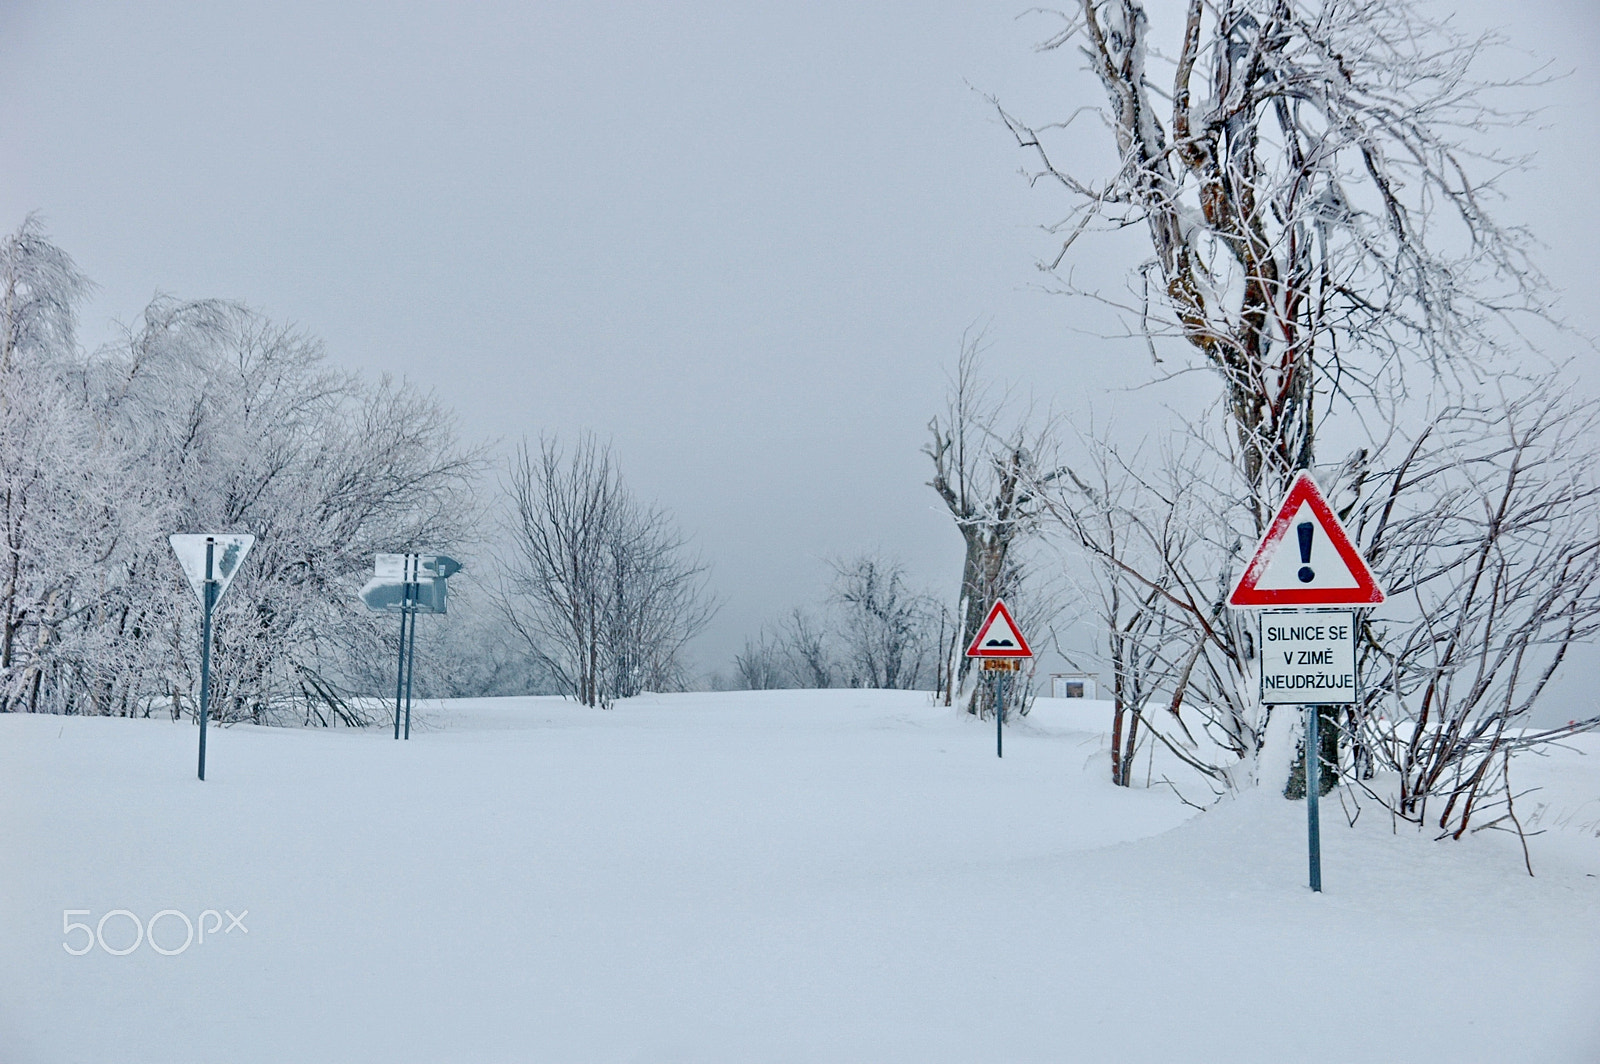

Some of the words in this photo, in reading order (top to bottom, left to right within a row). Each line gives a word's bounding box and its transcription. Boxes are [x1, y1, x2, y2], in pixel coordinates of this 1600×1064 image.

[1267, 626, 1325, 641] SILNICE
[1328, 626, 1348, 640] SE
[1283, 651, 1293, 665] V
[1297, 648, 1334, 665] ZIMĚ
[1265, 671, 1354, 689] NEUDRŽUJE
